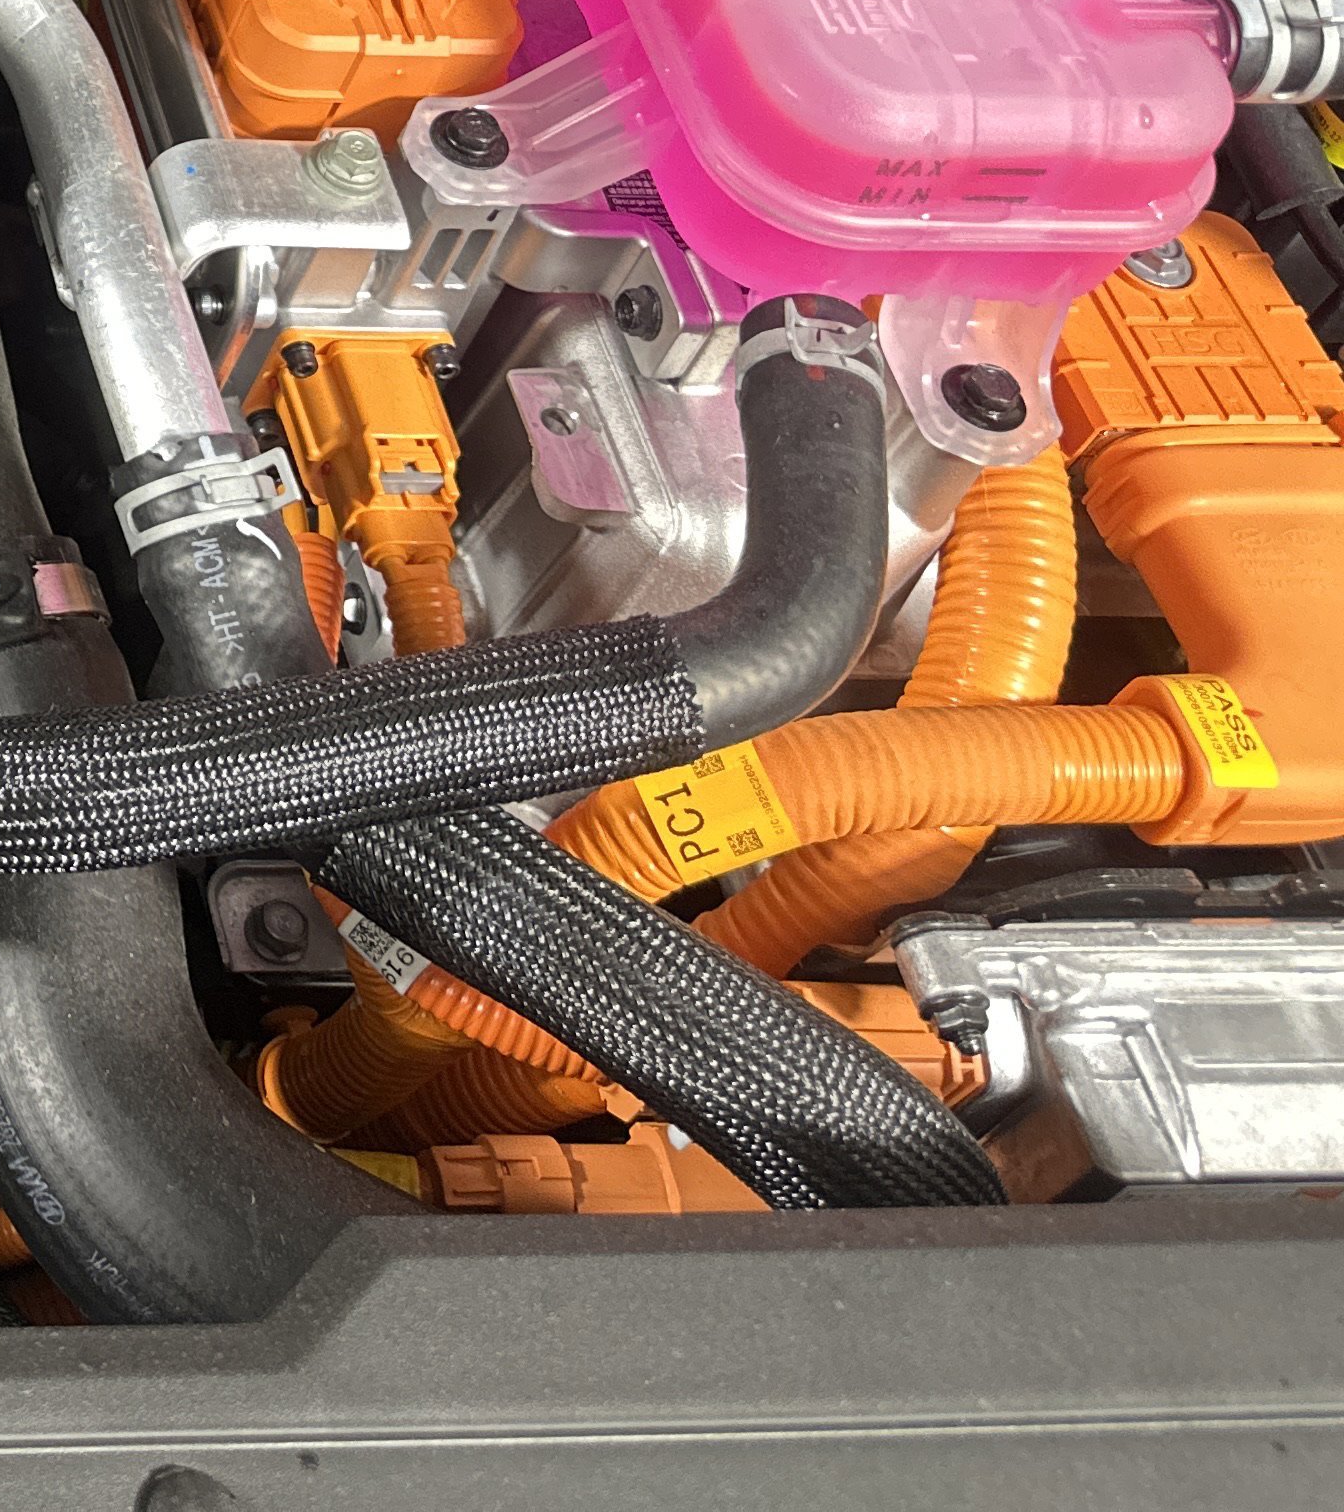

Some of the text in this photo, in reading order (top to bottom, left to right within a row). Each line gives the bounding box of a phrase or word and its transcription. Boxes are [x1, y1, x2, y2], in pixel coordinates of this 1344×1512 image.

[876, 159, 949, 178] MAX
[858, 185, 932, 205] MIN
[1150, 329, 1246, 355] HSG
[1200, 679, 1257, 752] PASS
[653, 782, 720, 863] PC1
